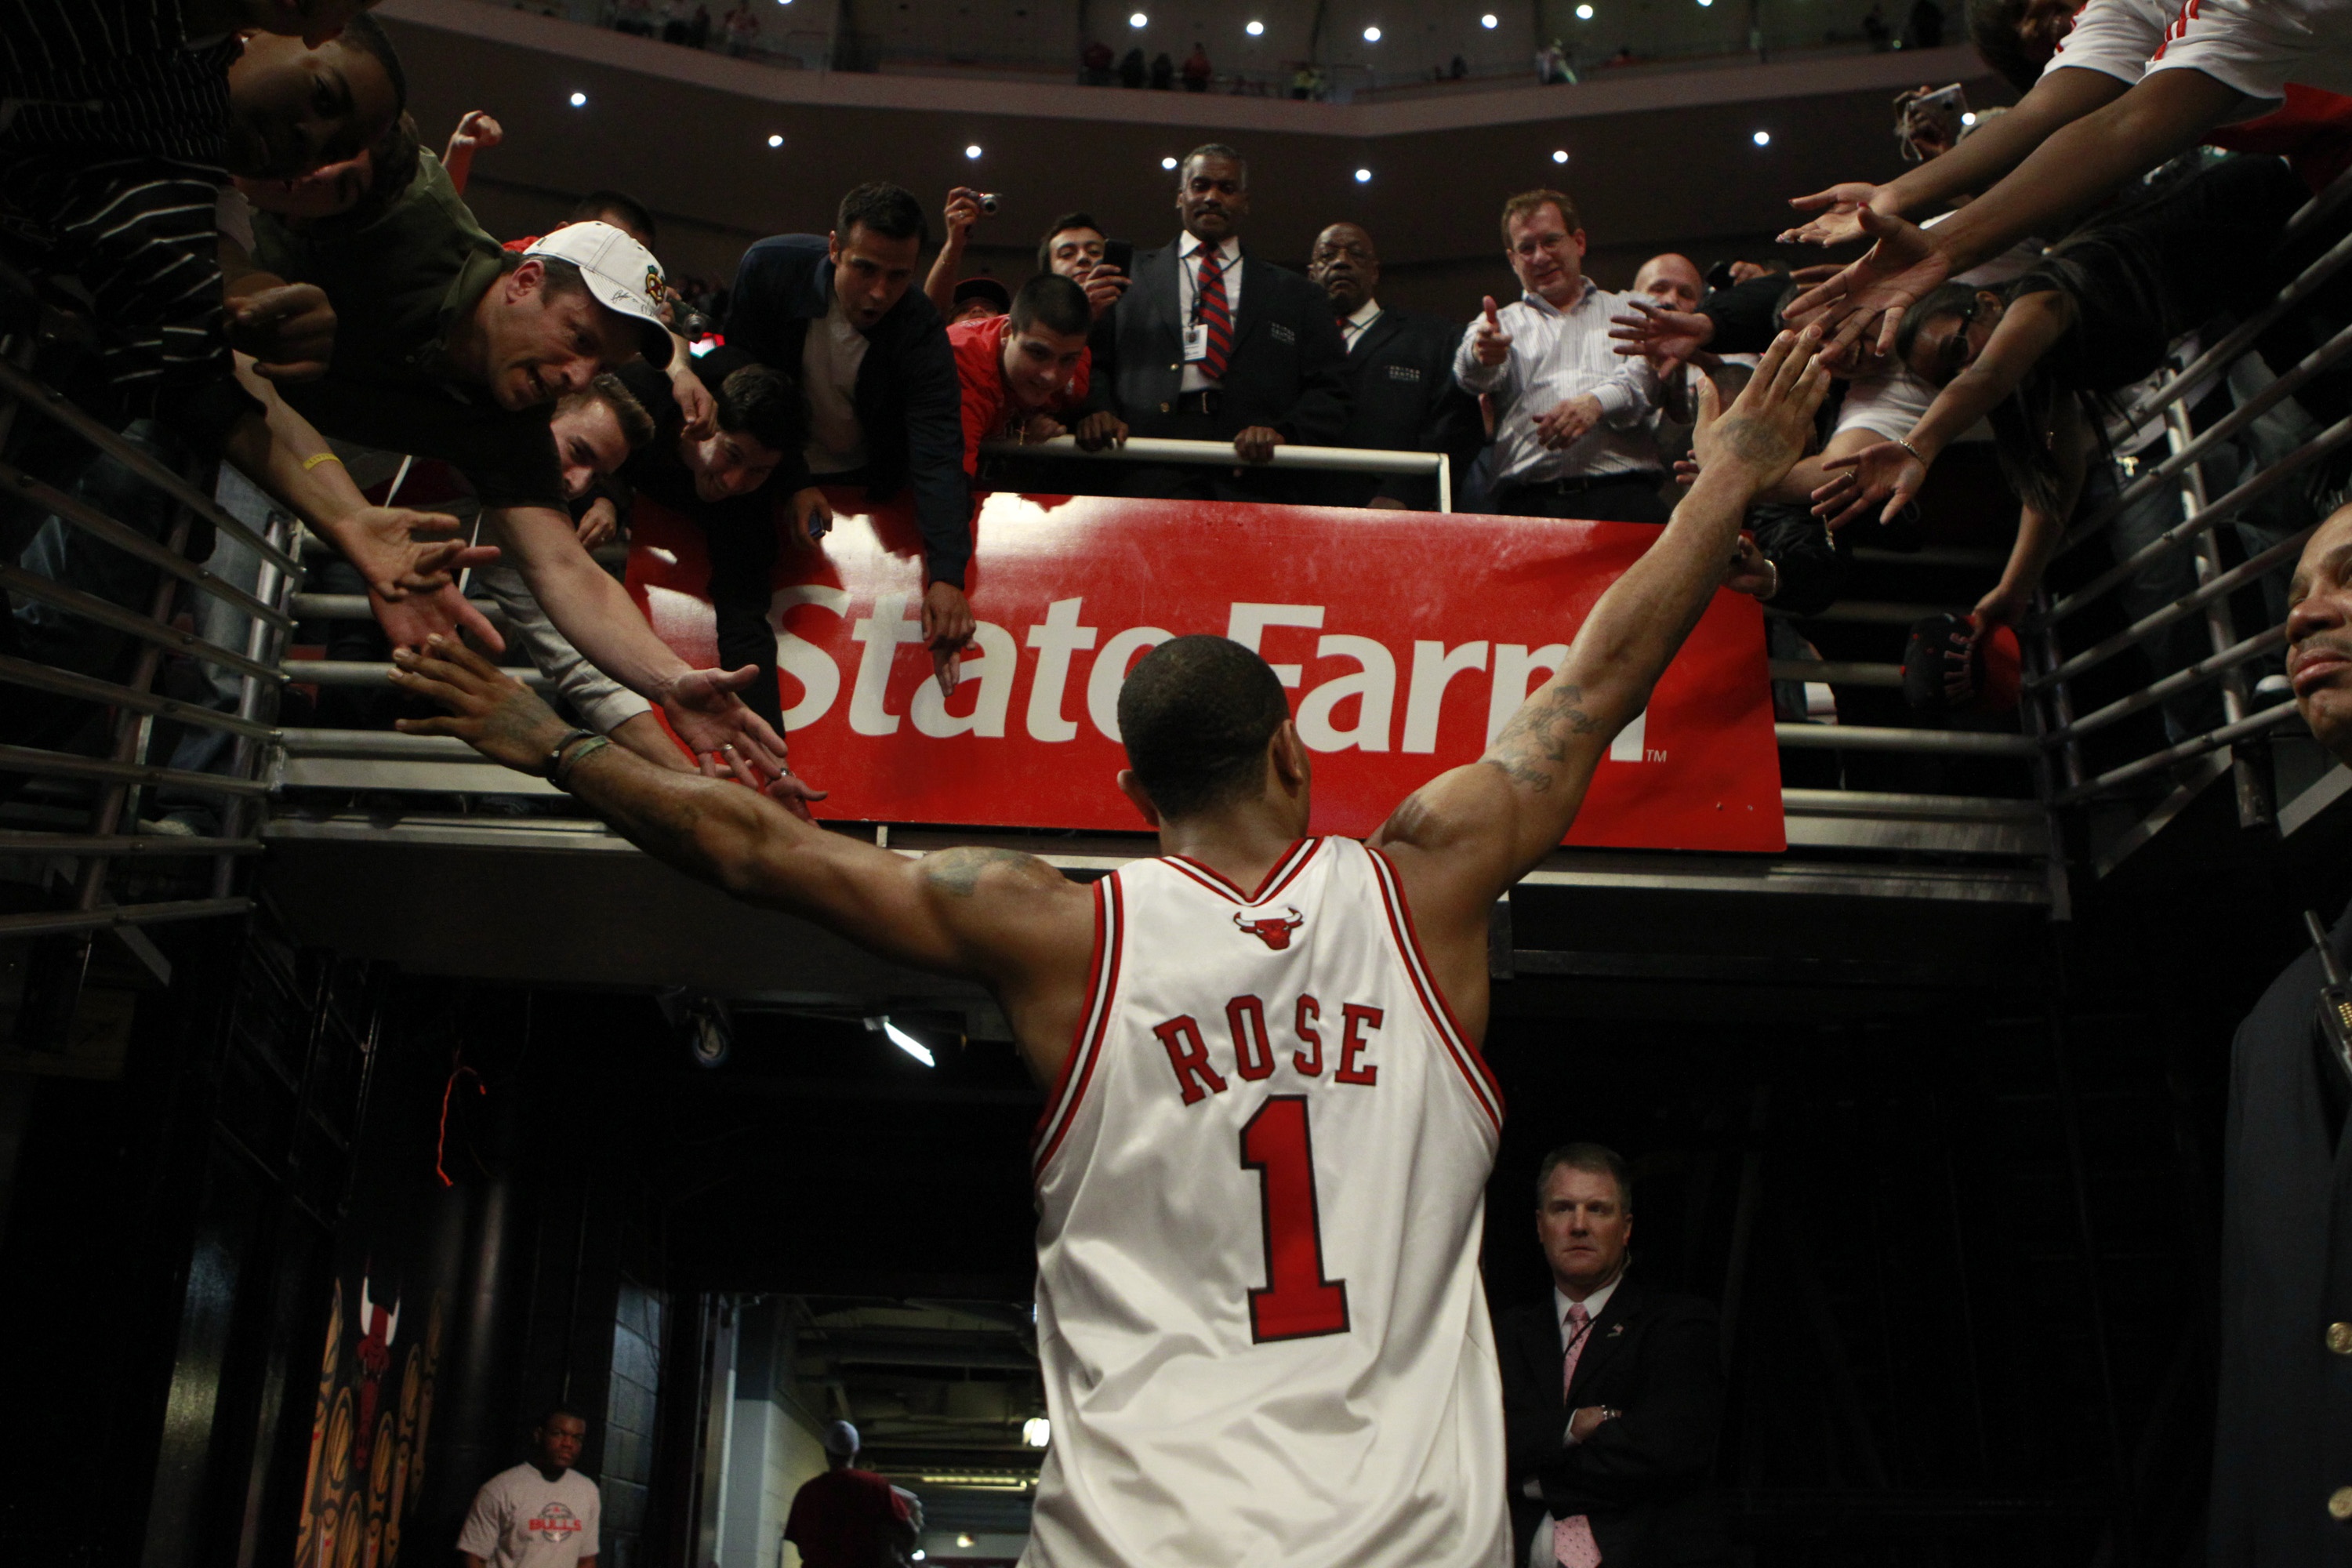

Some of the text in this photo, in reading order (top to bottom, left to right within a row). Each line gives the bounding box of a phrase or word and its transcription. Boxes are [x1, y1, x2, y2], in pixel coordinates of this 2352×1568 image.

[1153, 993, 1384, 1106] ROSE
[1239, 1094, 1351, 1344] 1
[529, 1519, 582, 1531] BULLS
